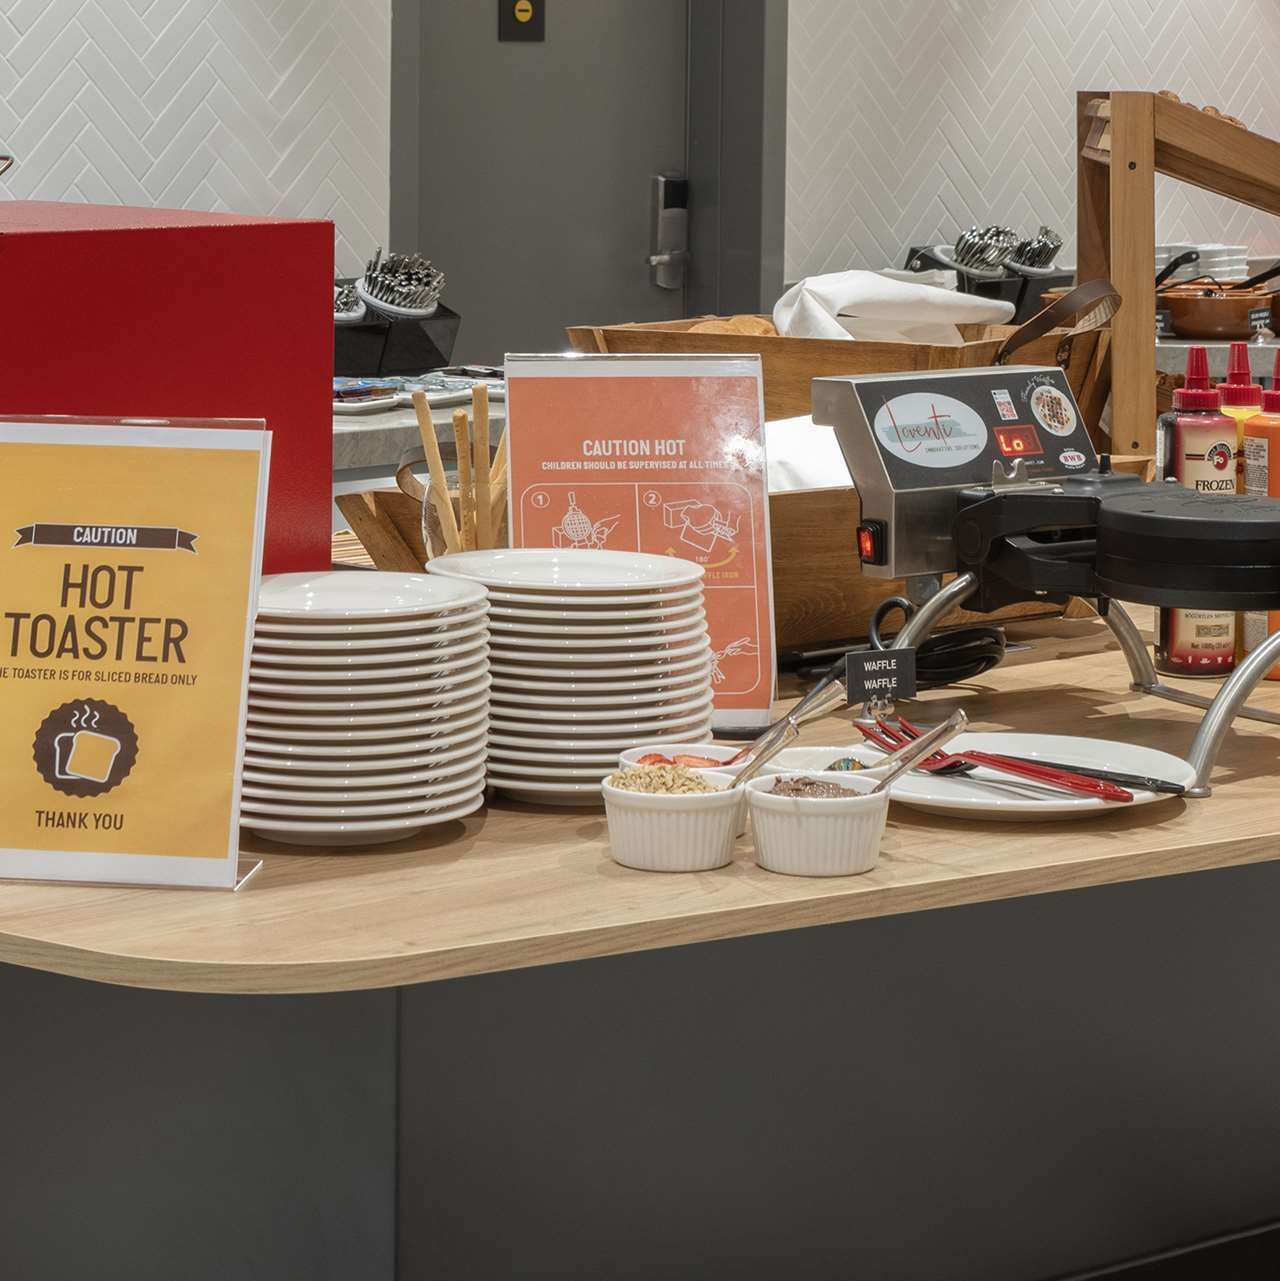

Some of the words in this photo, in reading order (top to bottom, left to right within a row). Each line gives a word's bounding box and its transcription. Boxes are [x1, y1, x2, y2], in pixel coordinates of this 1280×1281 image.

[583, 440, 650, 456] CAUTION
[655, 439, 686, 456] HOT
[542, 461, 582, 470] CHILDREN
[583, 461, 615, 470] SHOULD
[617, 461, 627, 470] BE
[629, 461, 677, 470] SUPERVISED
[678, 461, 687, 470] AT
[689, 461, 704, 470] ALL
[705, 460, 730, 470] TIME
[1195, 479, 1235, 491] FROZEN
[536, 495, 545, 505] 1
[648, 494, 657, 505] 2
[73, 526, 138, 546] CAUTION
[60, 563, 144, 610] HOT
[4, 612, 189, 663] TOASTER
[863, 659, 897, 671] WAFFLE
[11, 667, 56, 681] TOASTER
[58, 668, 70, 681] IS
[71, 669, 92, 682] FOR
[94, 670, 131, 684] SLICED
[133, 672, 168, 685] BREAD
[170, 673, 198, 686] ONLY
[863, 677, 897, 690] WAFFLE
[35, 810, 89, 830] THANK
[93, 812, 124, 831] YOU
